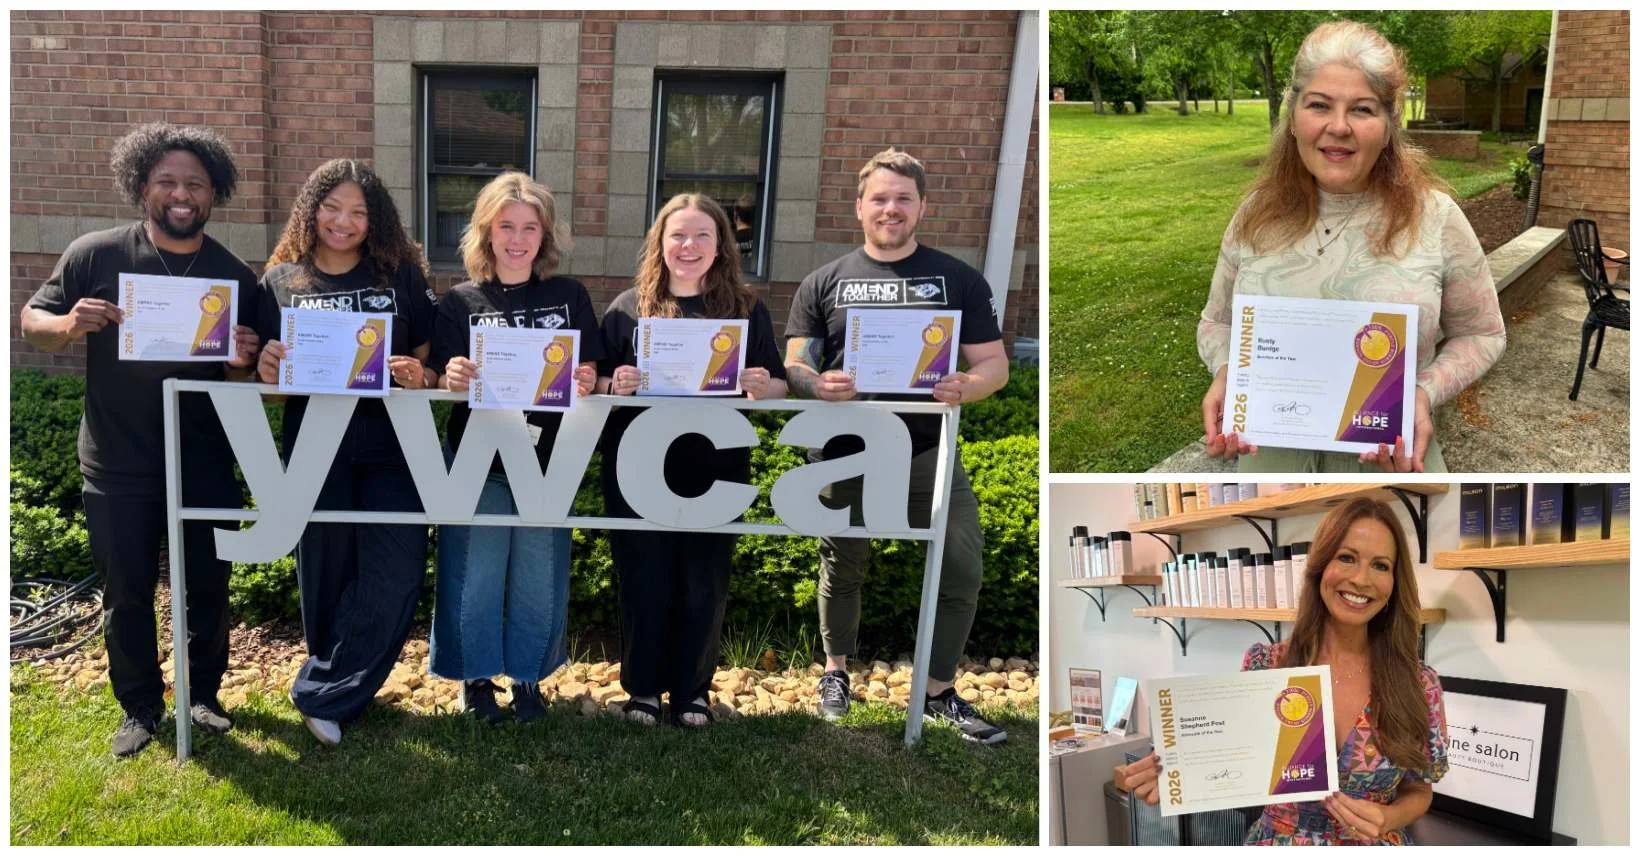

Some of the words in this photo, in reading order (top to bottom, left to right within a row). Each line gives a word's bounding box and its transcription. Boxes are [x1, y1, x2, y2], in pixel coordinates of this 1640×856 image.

[843, 283, 899, 296] AMEND
[843, 294, 898, 302] TOGETHER
[1238, 305, 1255, 368] WINNER
[1232, 393, 1249, 433] 2026
[1352, 414, 1389, 428] HOPE
[210, 391, 913, 561] ywca
[1158, 688, 1176, 748] WINNER
[1475, 744, 1520, 762] salon
[1282, 767, 1315, 780] HOPE
[1167, 770, 1182, 805] 2026
